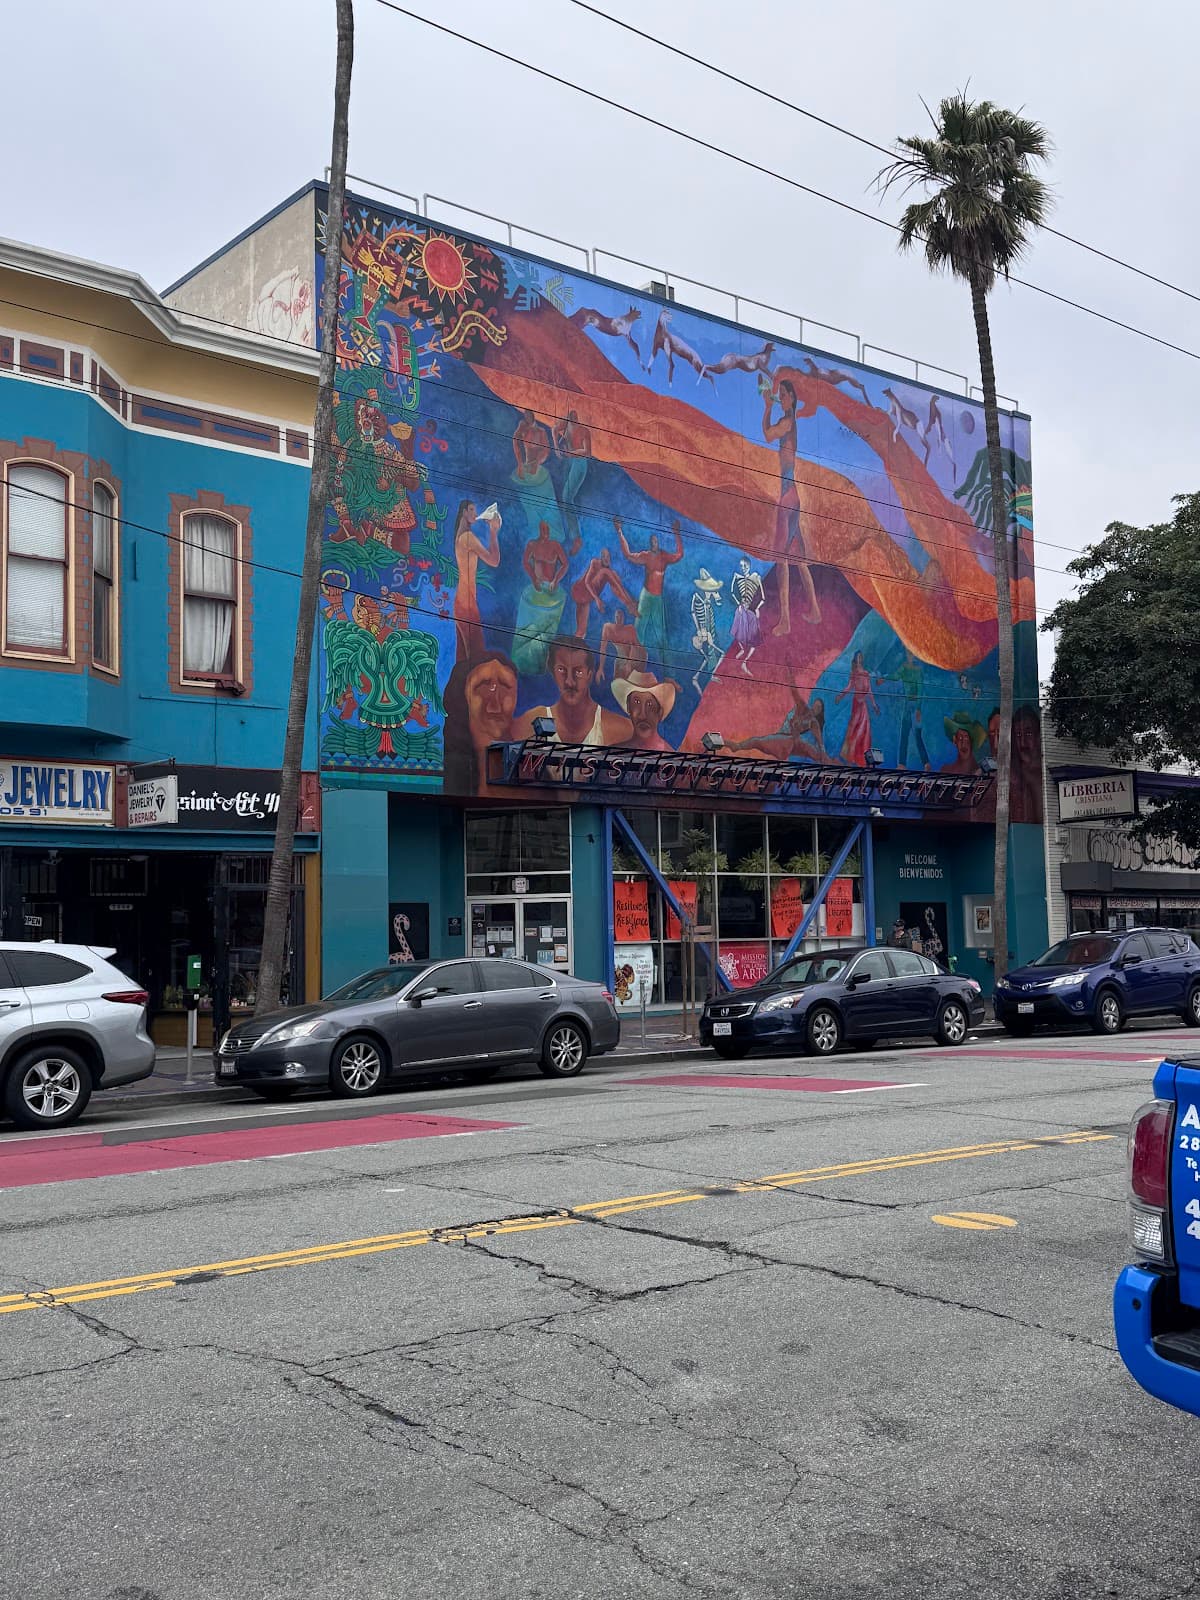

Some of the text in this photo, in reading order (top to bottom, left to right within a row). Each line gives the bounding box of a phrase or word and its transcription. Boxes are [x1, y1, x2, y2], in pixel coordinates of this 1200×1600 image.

[5, 766, 111, 809] JEWELRY
[129, 782, 155, 797] DANIEL'S
[1063, 781, 1126, 797] LIBRERIA
[129, 796, 154, 810] JEWELRY
[134, 810, 157, 823] REPAIRS
[904, 854, 937, 865] WELCOME
[899, 868, 944, 879] BIENVENIDOS
